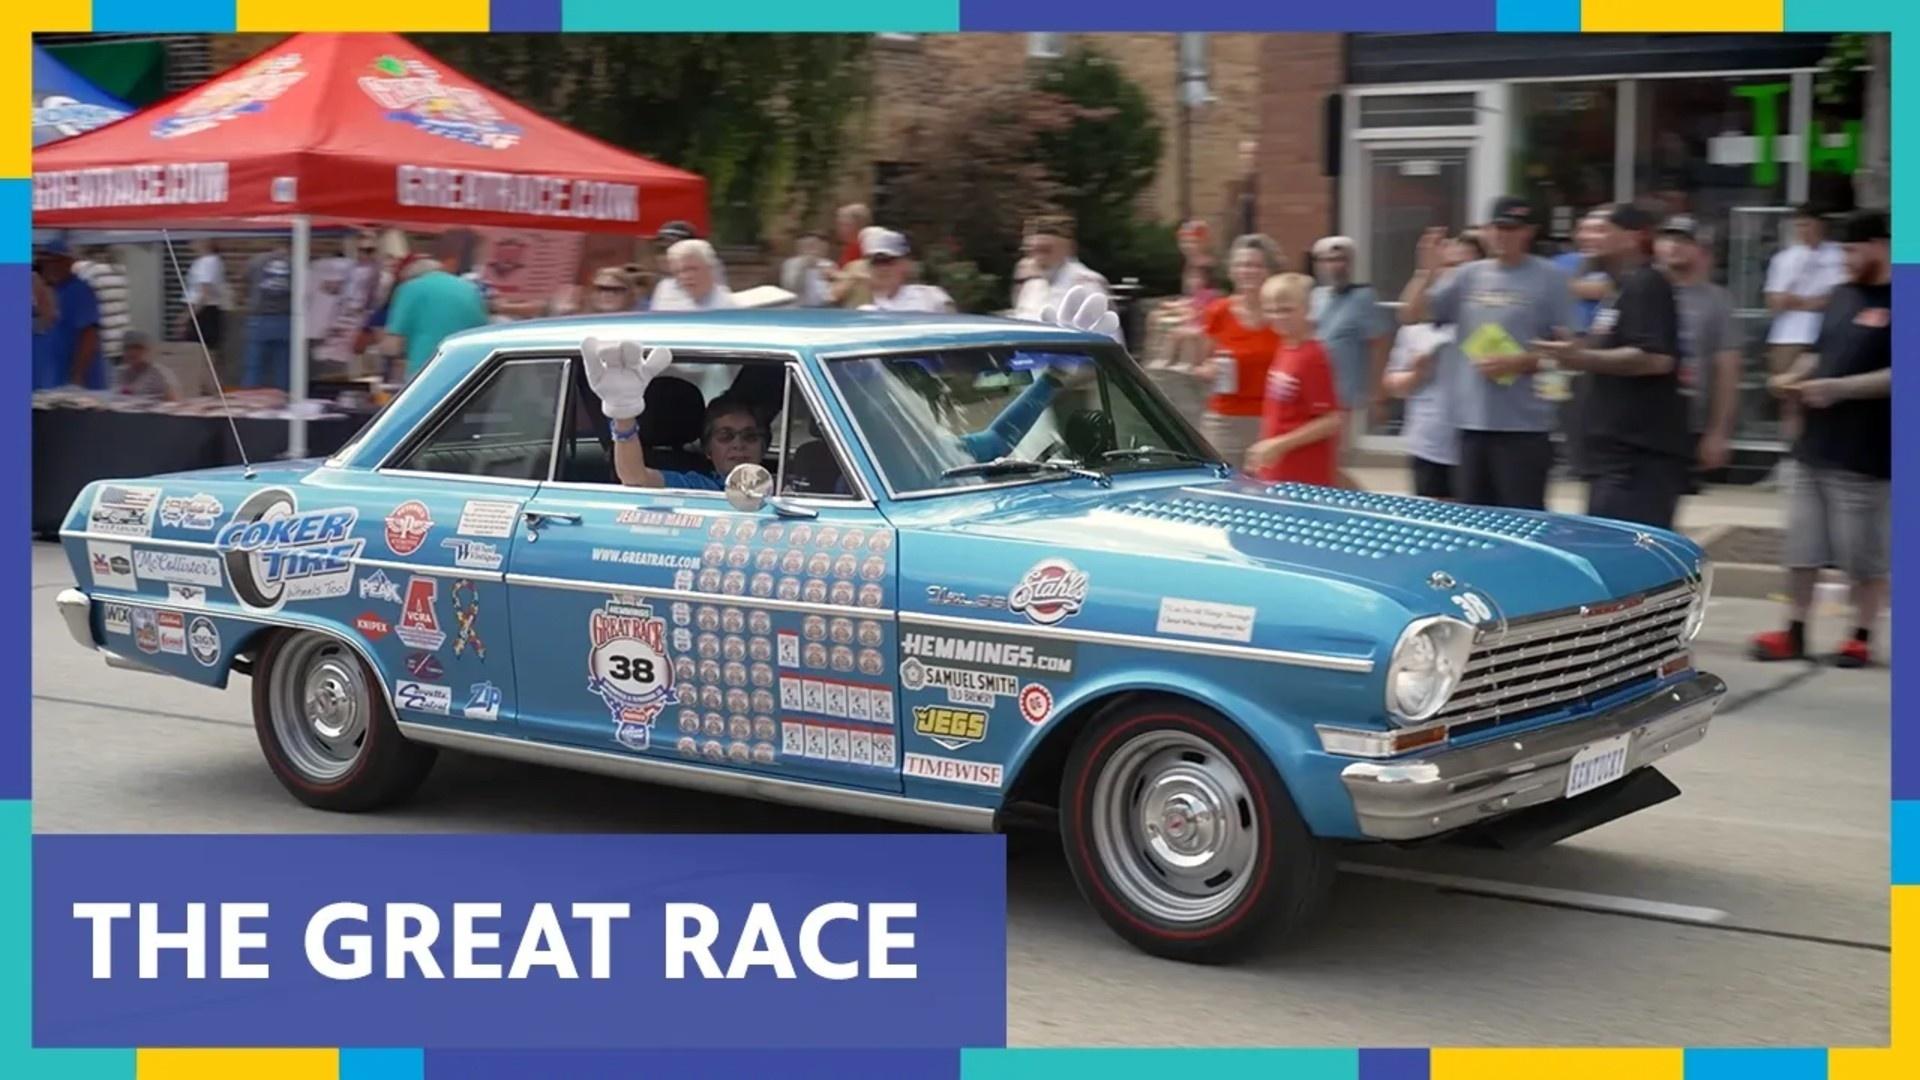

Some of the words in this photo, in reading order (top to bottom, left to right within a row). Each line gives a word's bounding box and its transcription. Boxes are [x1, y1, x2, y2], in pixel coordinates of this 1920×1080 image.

[219, 512, 353, 548] COKER
[135, 549, 218, 577] McCollister's
[262, 543, 359, 581] TIRE
[592, 548, 700, 569] WWW.GREATRACE.COM
[359, 576, 403, 604] PEAK
[356, 617, 388, 633] KNIPEX
[593, 613, 632, 646] GREAT
[632, 616, 664, 655] RACE
[901, 633, 1073, 673] HEMMINGS.COM
[609, 655, 655, 684] 38
[926, 668, 978, 690] SAMUEL
[979, 673, 1017, 694] SMITH
[917, 709, 985, 738] JEGS
[907, 757, 1000, 785] TIMEWISE
